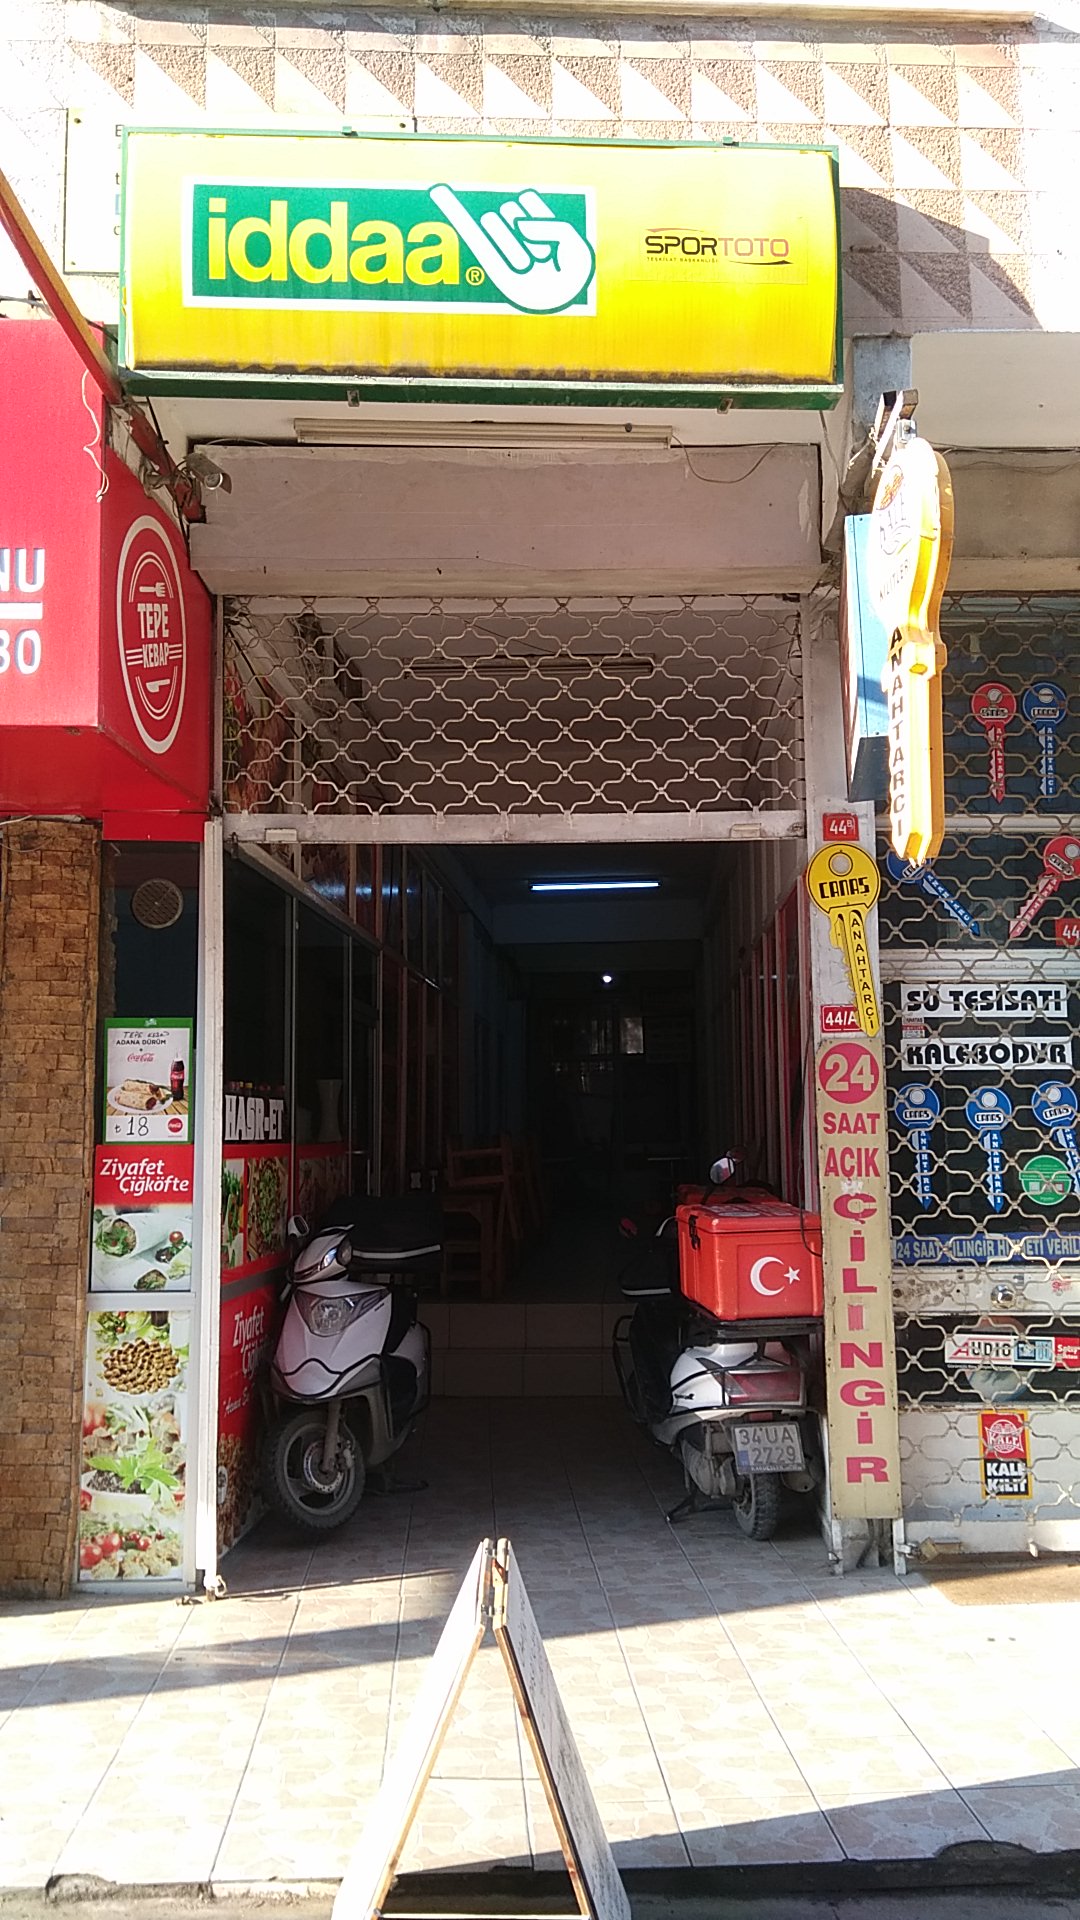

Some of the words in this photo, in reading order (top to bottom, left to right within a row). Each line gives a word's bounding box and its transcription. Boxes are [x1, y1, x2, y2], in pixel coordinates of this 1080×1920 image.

[208, 197, 461, 286] iddaa
[645, 235, 790, 258] SPORTOTO
[137, 603, 169, 639] TEPE
[142, 642, 169, 668] KEBAP
[907, 990, 941, 1012] SU
[825, 1053, 875, 1092] 24
[126, 1116, 149, 1136] 18
[822, 1112, 881, 1135] SAAT
[99, 1158, 166, 1181] Ziyafet
[823, 1146, 881, 1184] AÇIK
[118, 1174, 190, 1197] Çiğköfte
[897, 1241, 911, 1259] 24
[913, 1241, 941, 1259] SAAT
[765, 1427, 795, 1444] UA
